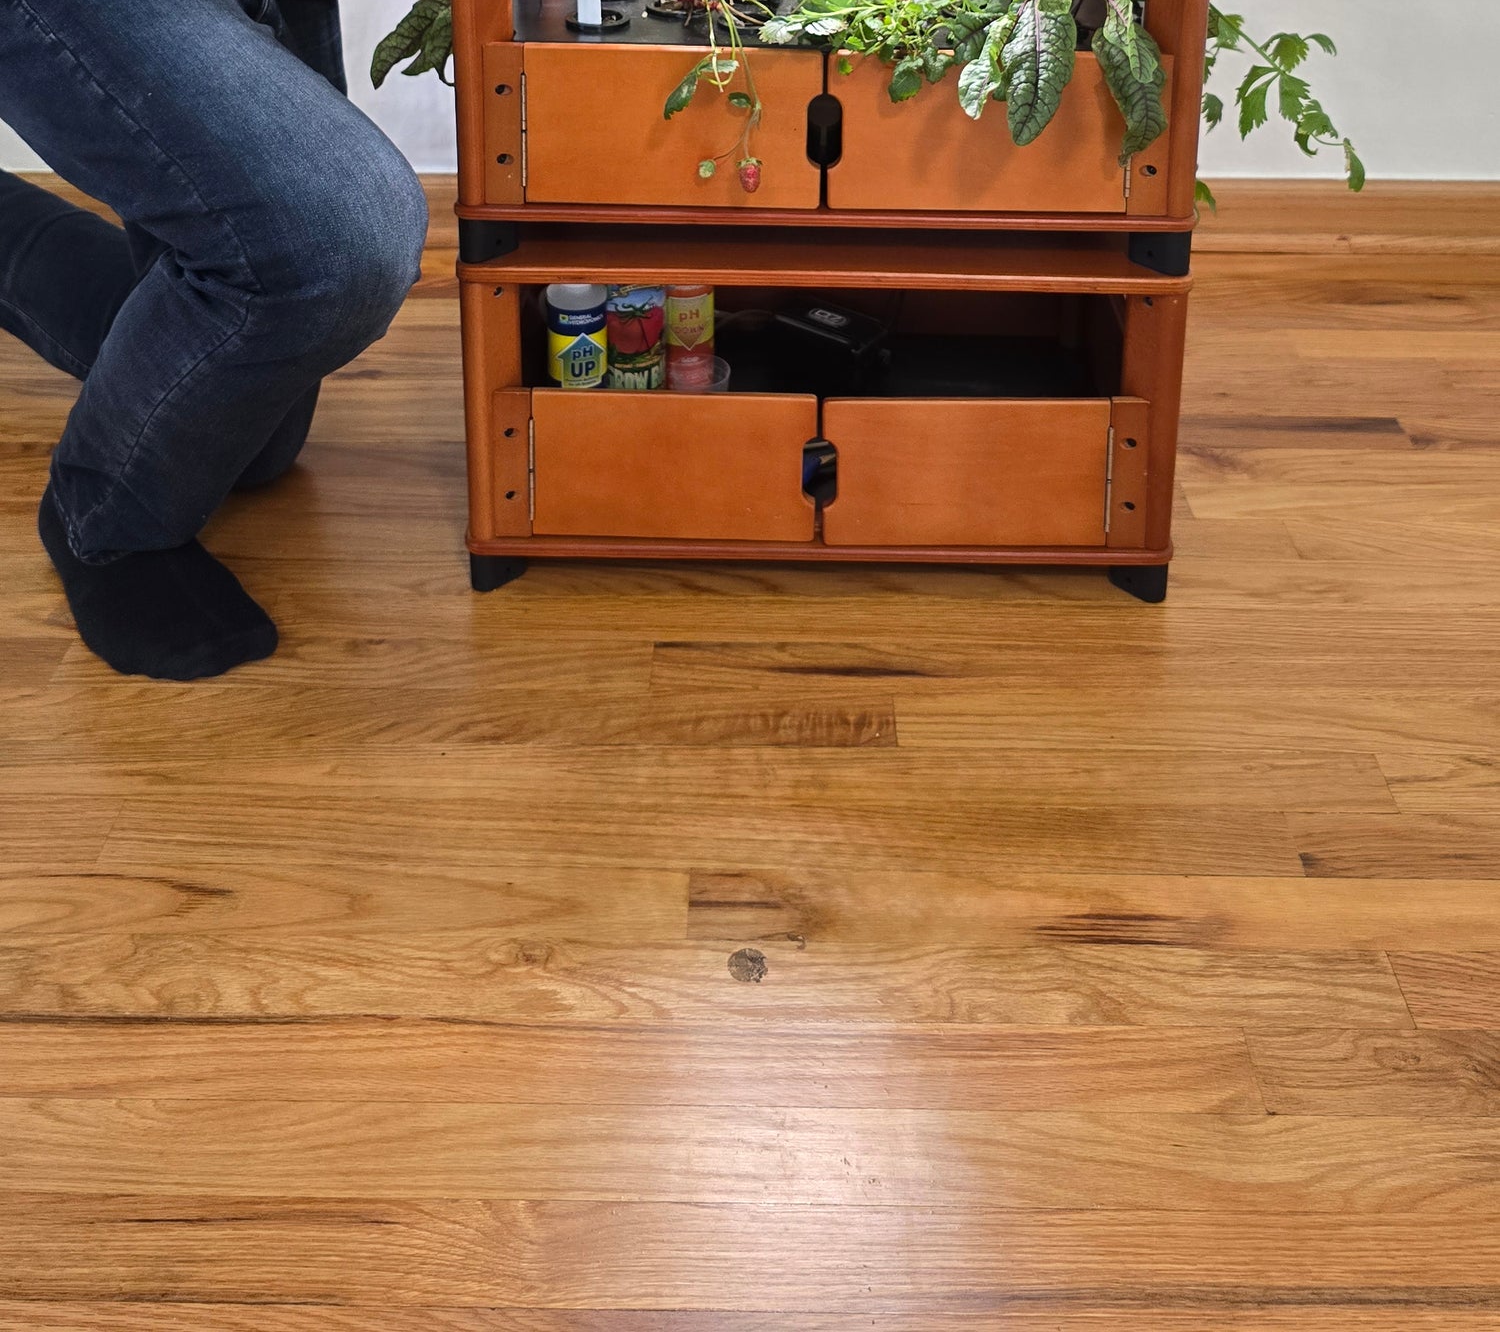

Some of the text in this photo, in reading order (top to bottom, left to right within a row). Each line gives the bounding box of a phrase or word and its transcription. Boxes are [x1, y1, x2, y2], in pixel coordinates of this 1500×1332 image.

[678, 308, 700, 323] pH
[572, 345, 594, 361] pH
[571, 361, 596, 378] UP
